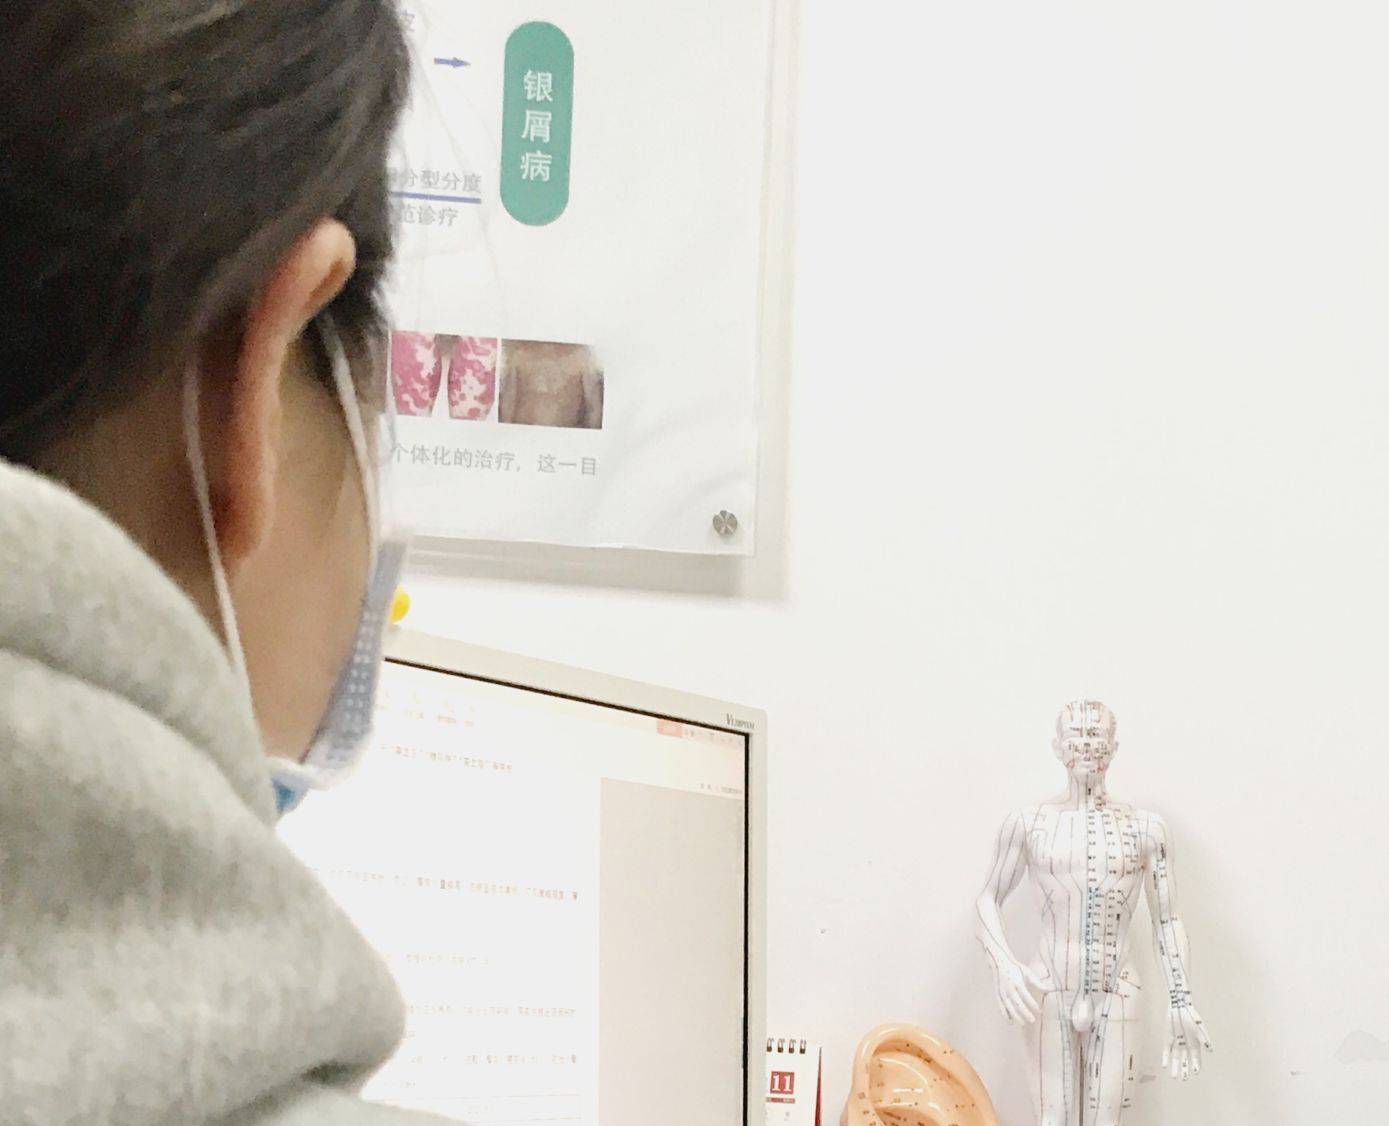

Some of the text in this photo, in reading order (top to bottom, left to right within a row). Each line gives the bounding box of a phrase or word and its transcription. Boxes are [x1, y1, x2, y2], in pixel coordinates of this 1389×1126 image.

[521, 70, 553, 181] 银屑病
[772, 1074, 792, 1092] 11
